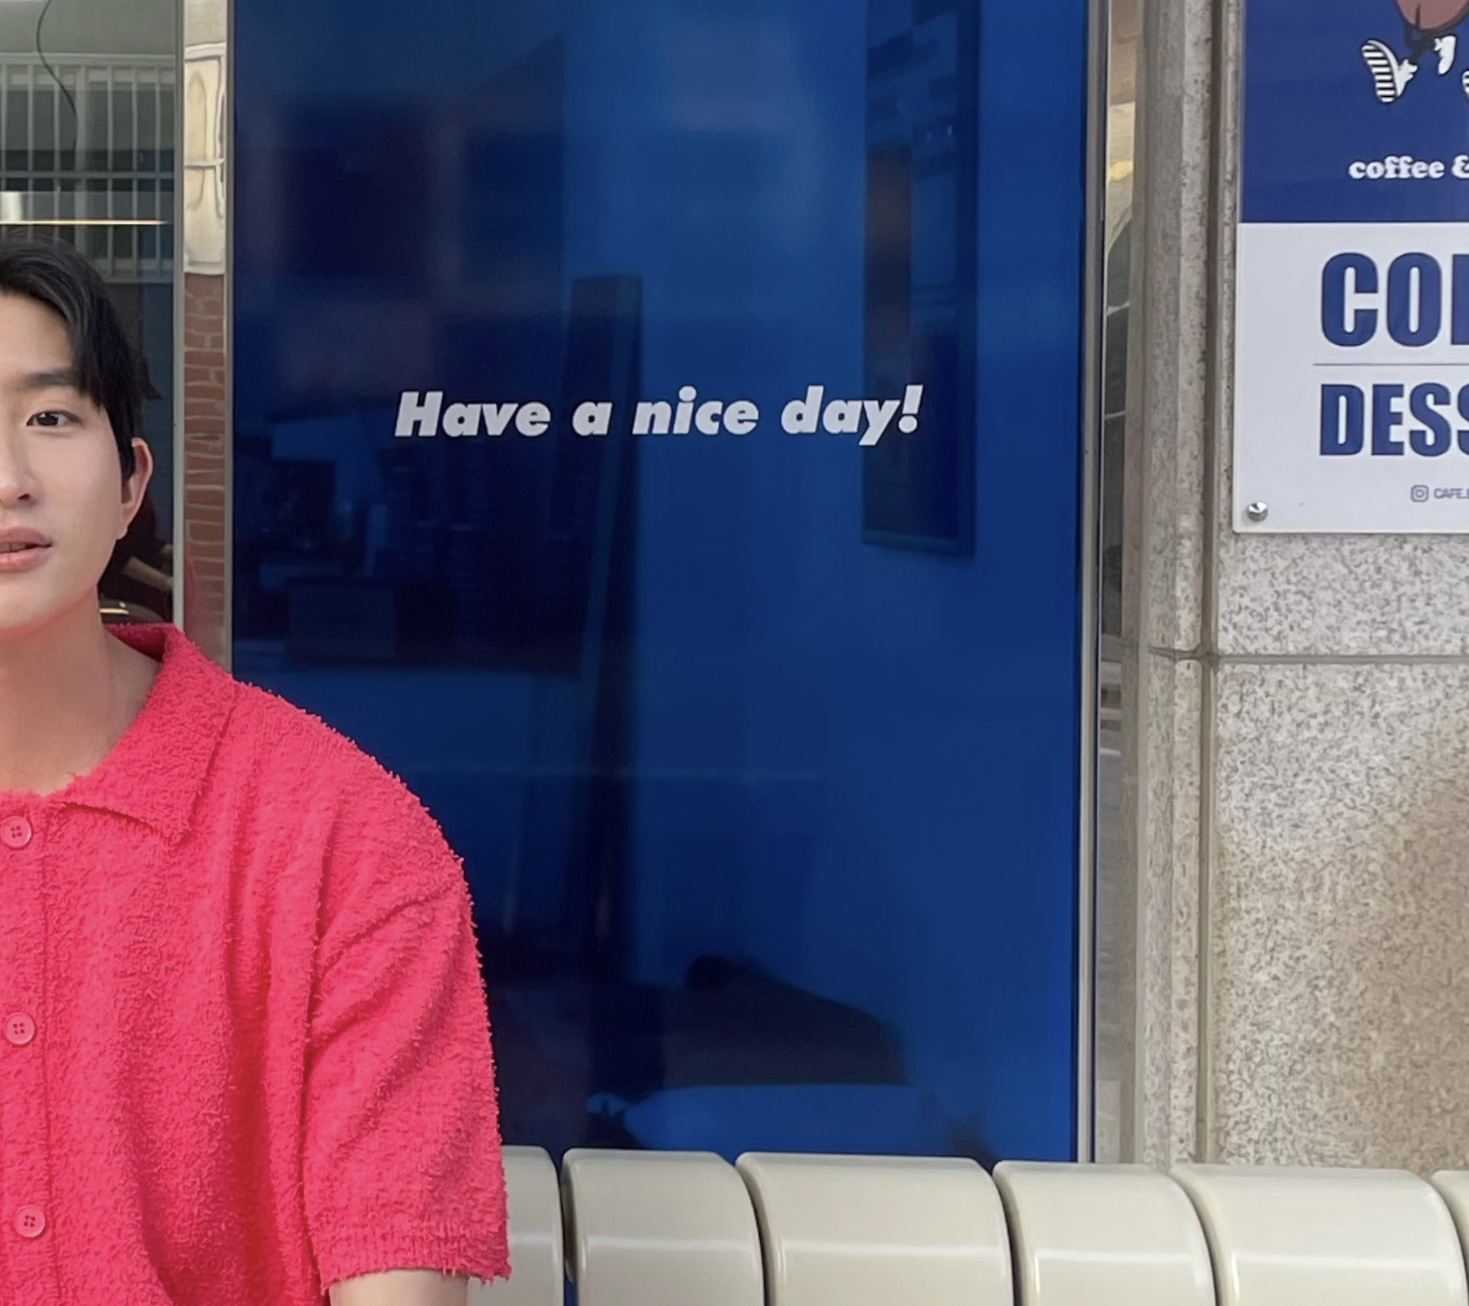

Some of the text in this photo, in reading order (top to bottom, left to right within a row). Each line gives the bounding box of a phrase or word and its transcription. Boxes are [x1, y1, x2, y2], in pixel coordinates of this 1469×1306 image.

[1348, 154, 1445, 180] coffee
[394, 384, 924, 446] Have a nice day!
[1319, 381, 1469, 458] DES
[1434, 487, 1469, 500] CAFE.
